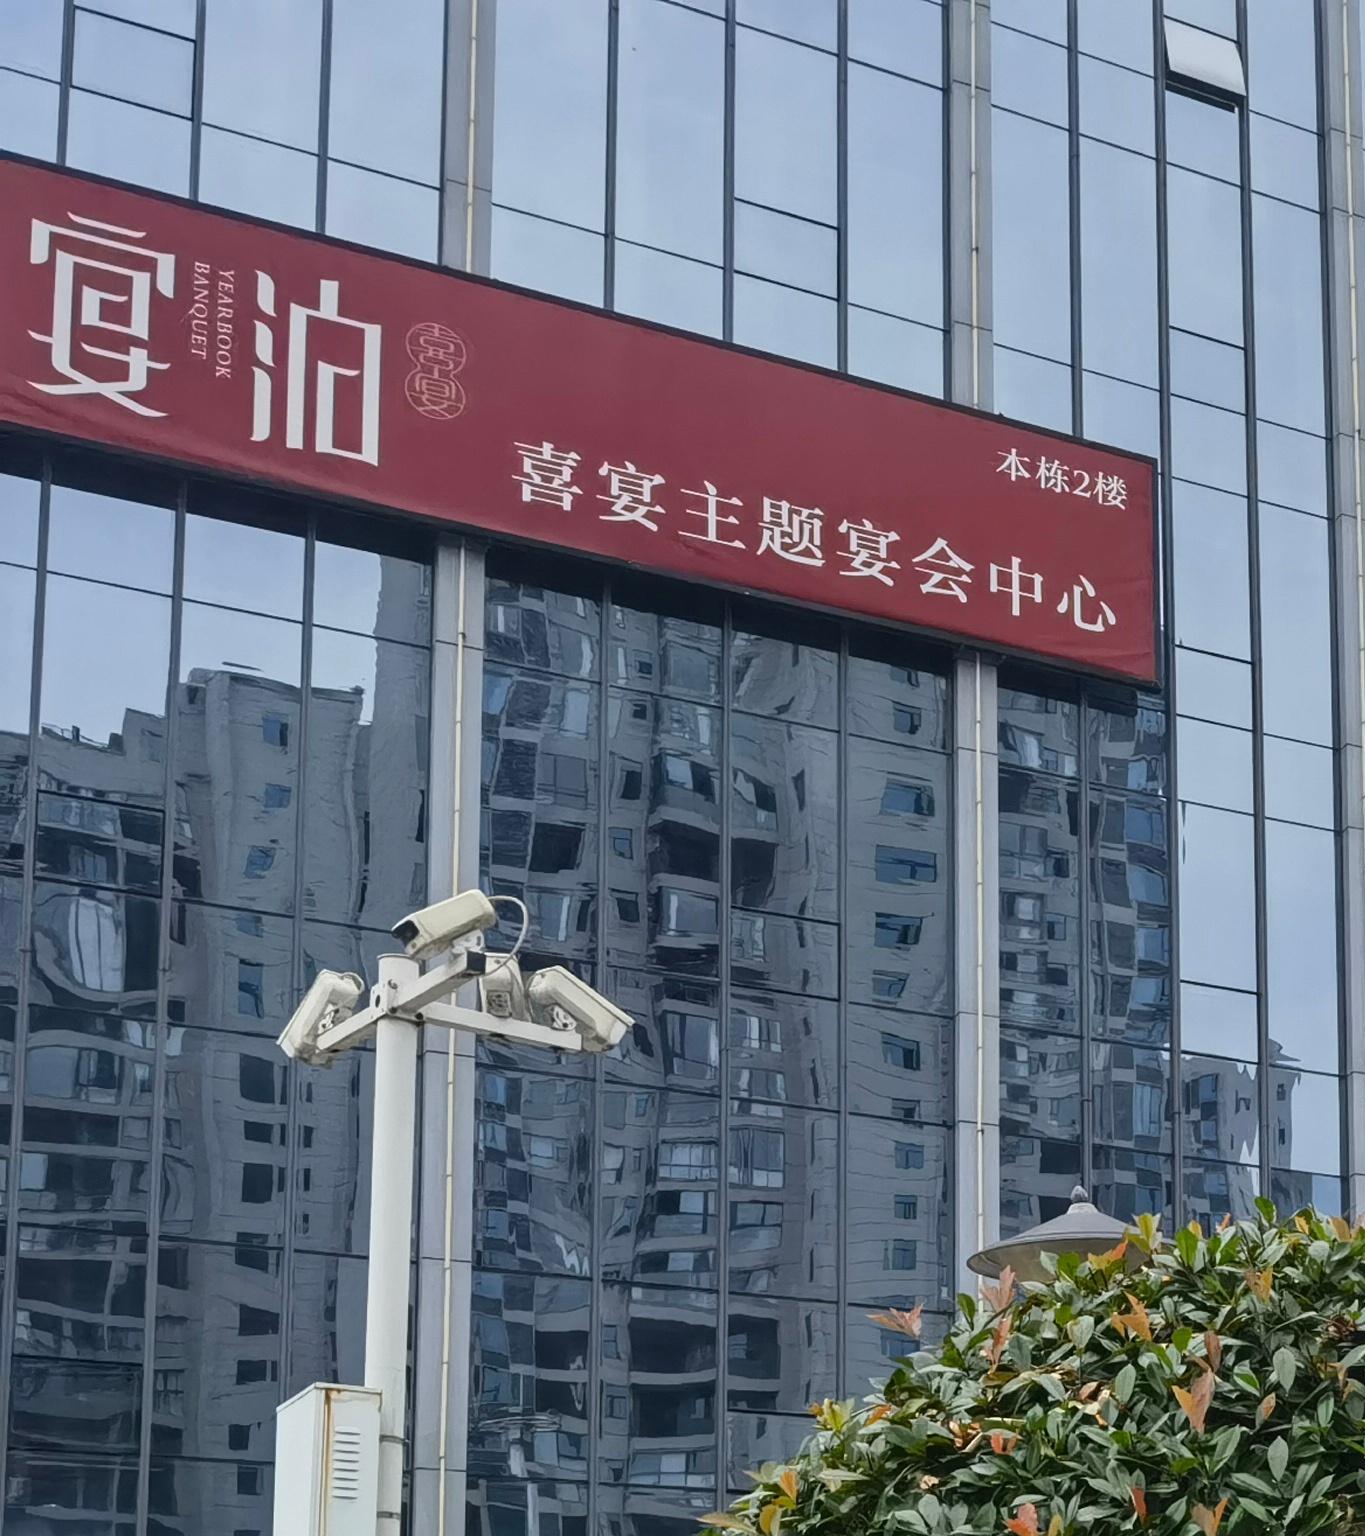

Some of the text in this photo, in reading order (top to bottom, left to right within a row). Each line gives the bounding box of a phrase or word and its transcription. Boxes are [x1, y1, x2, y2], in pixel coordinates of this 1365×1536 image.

[190, 261, 211, 360] BANQUET
[215, 269, 236, 379] YEARBOOK
[995, 447, 1129, 511] 本栋2楼
[511, 440, 1117, 634] 喜宴主题宴会中心
